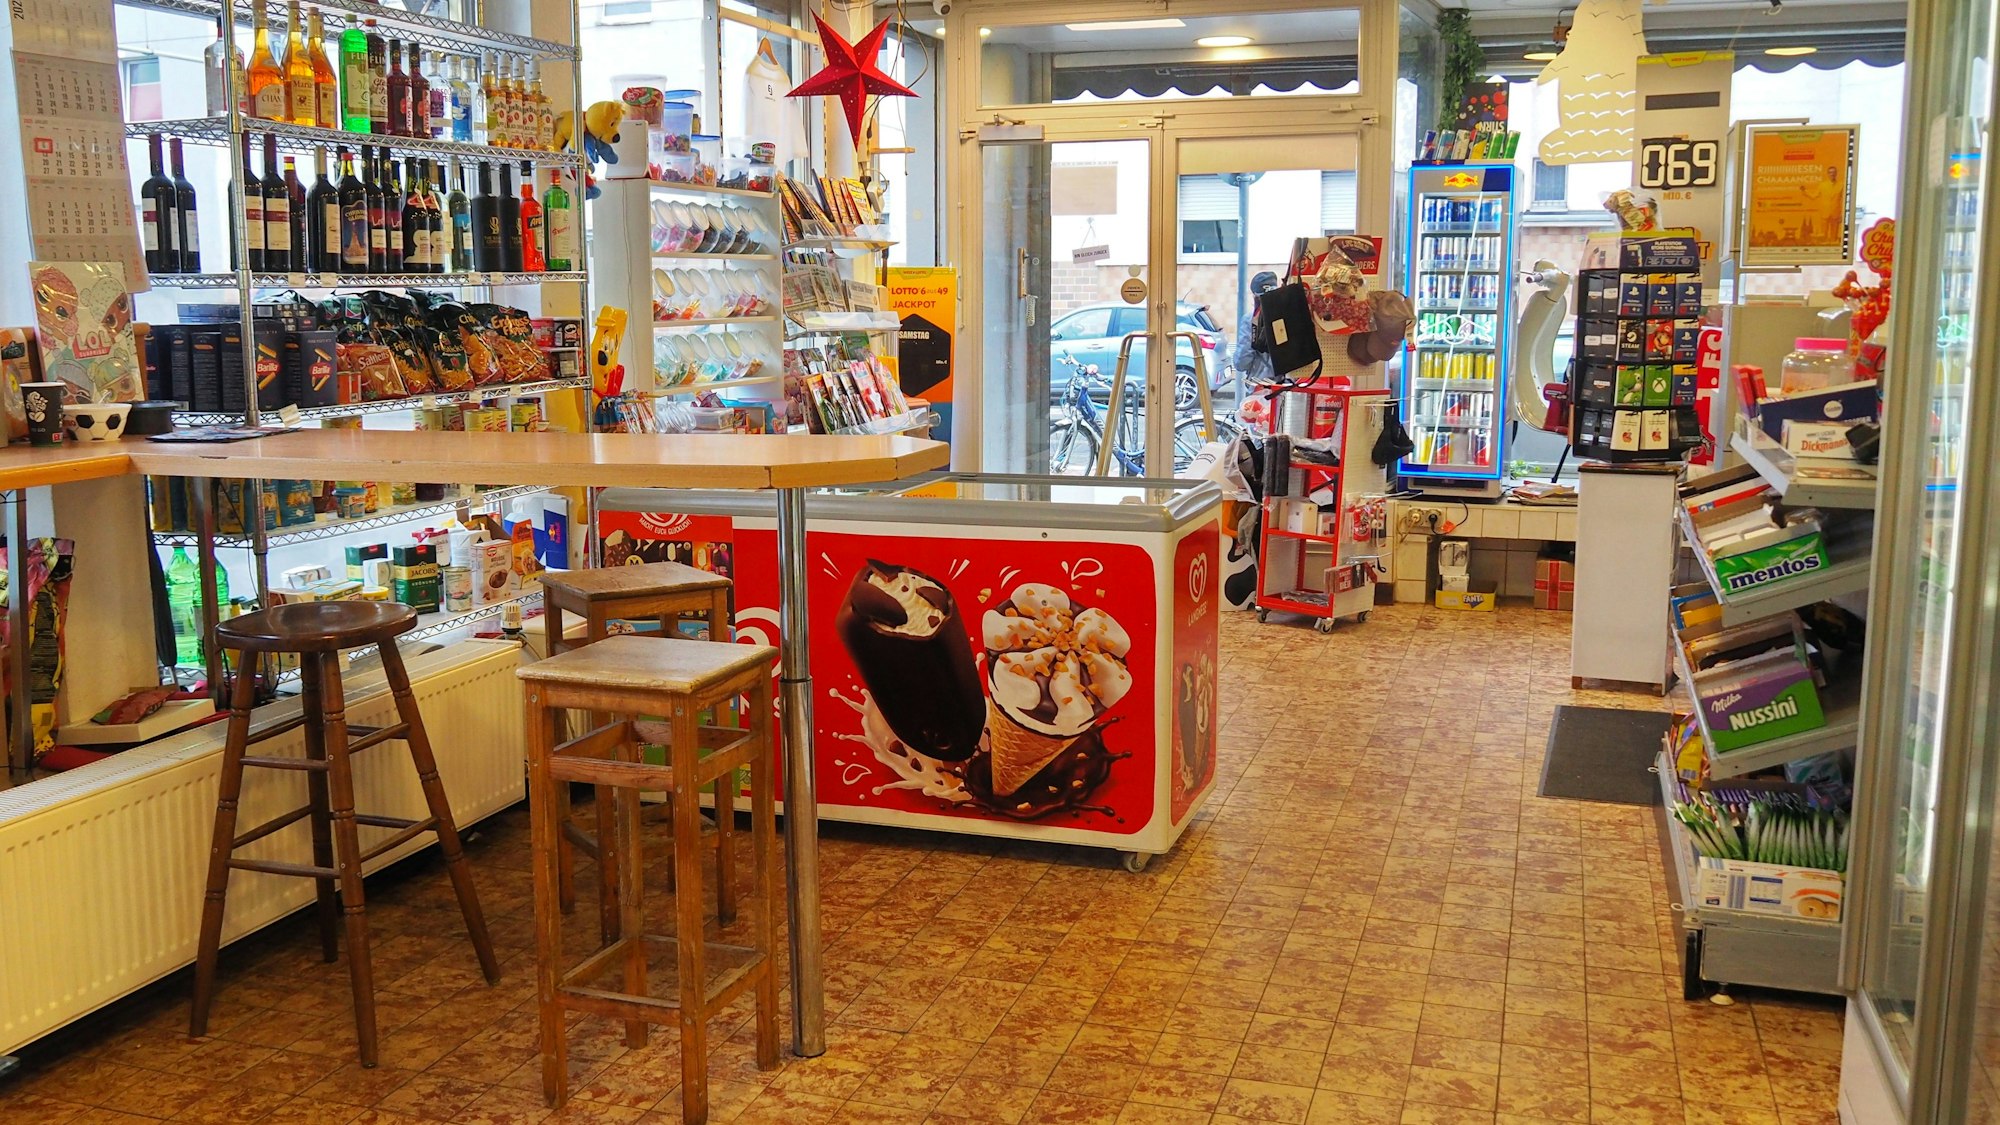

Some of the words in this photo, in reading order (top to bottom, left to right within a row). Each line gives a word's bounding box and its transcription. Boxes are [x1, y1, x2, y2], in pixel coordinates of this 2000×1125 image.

[1641, 142, 1717, 186] 069
[1663, 192, 1684, 200] MIO.
[891, 287, 919, 295] LOTTO
[920, 287, 926, 295] 6
[937, 287, 948, 295] 49
[892, 300, 936, 309] JACKPOT
[898, 331, 930, 340] SAMSTAG
[257, 363, 278, 372] Barilla
[312, 366, 331, 375] Barilla
[639, 517, 654, 531] MACHT
[411, 568, 436, 577] JACOBS
[1728, 554, 1821, 591] mentos
[1711, 693, 1742, 714] Milka
